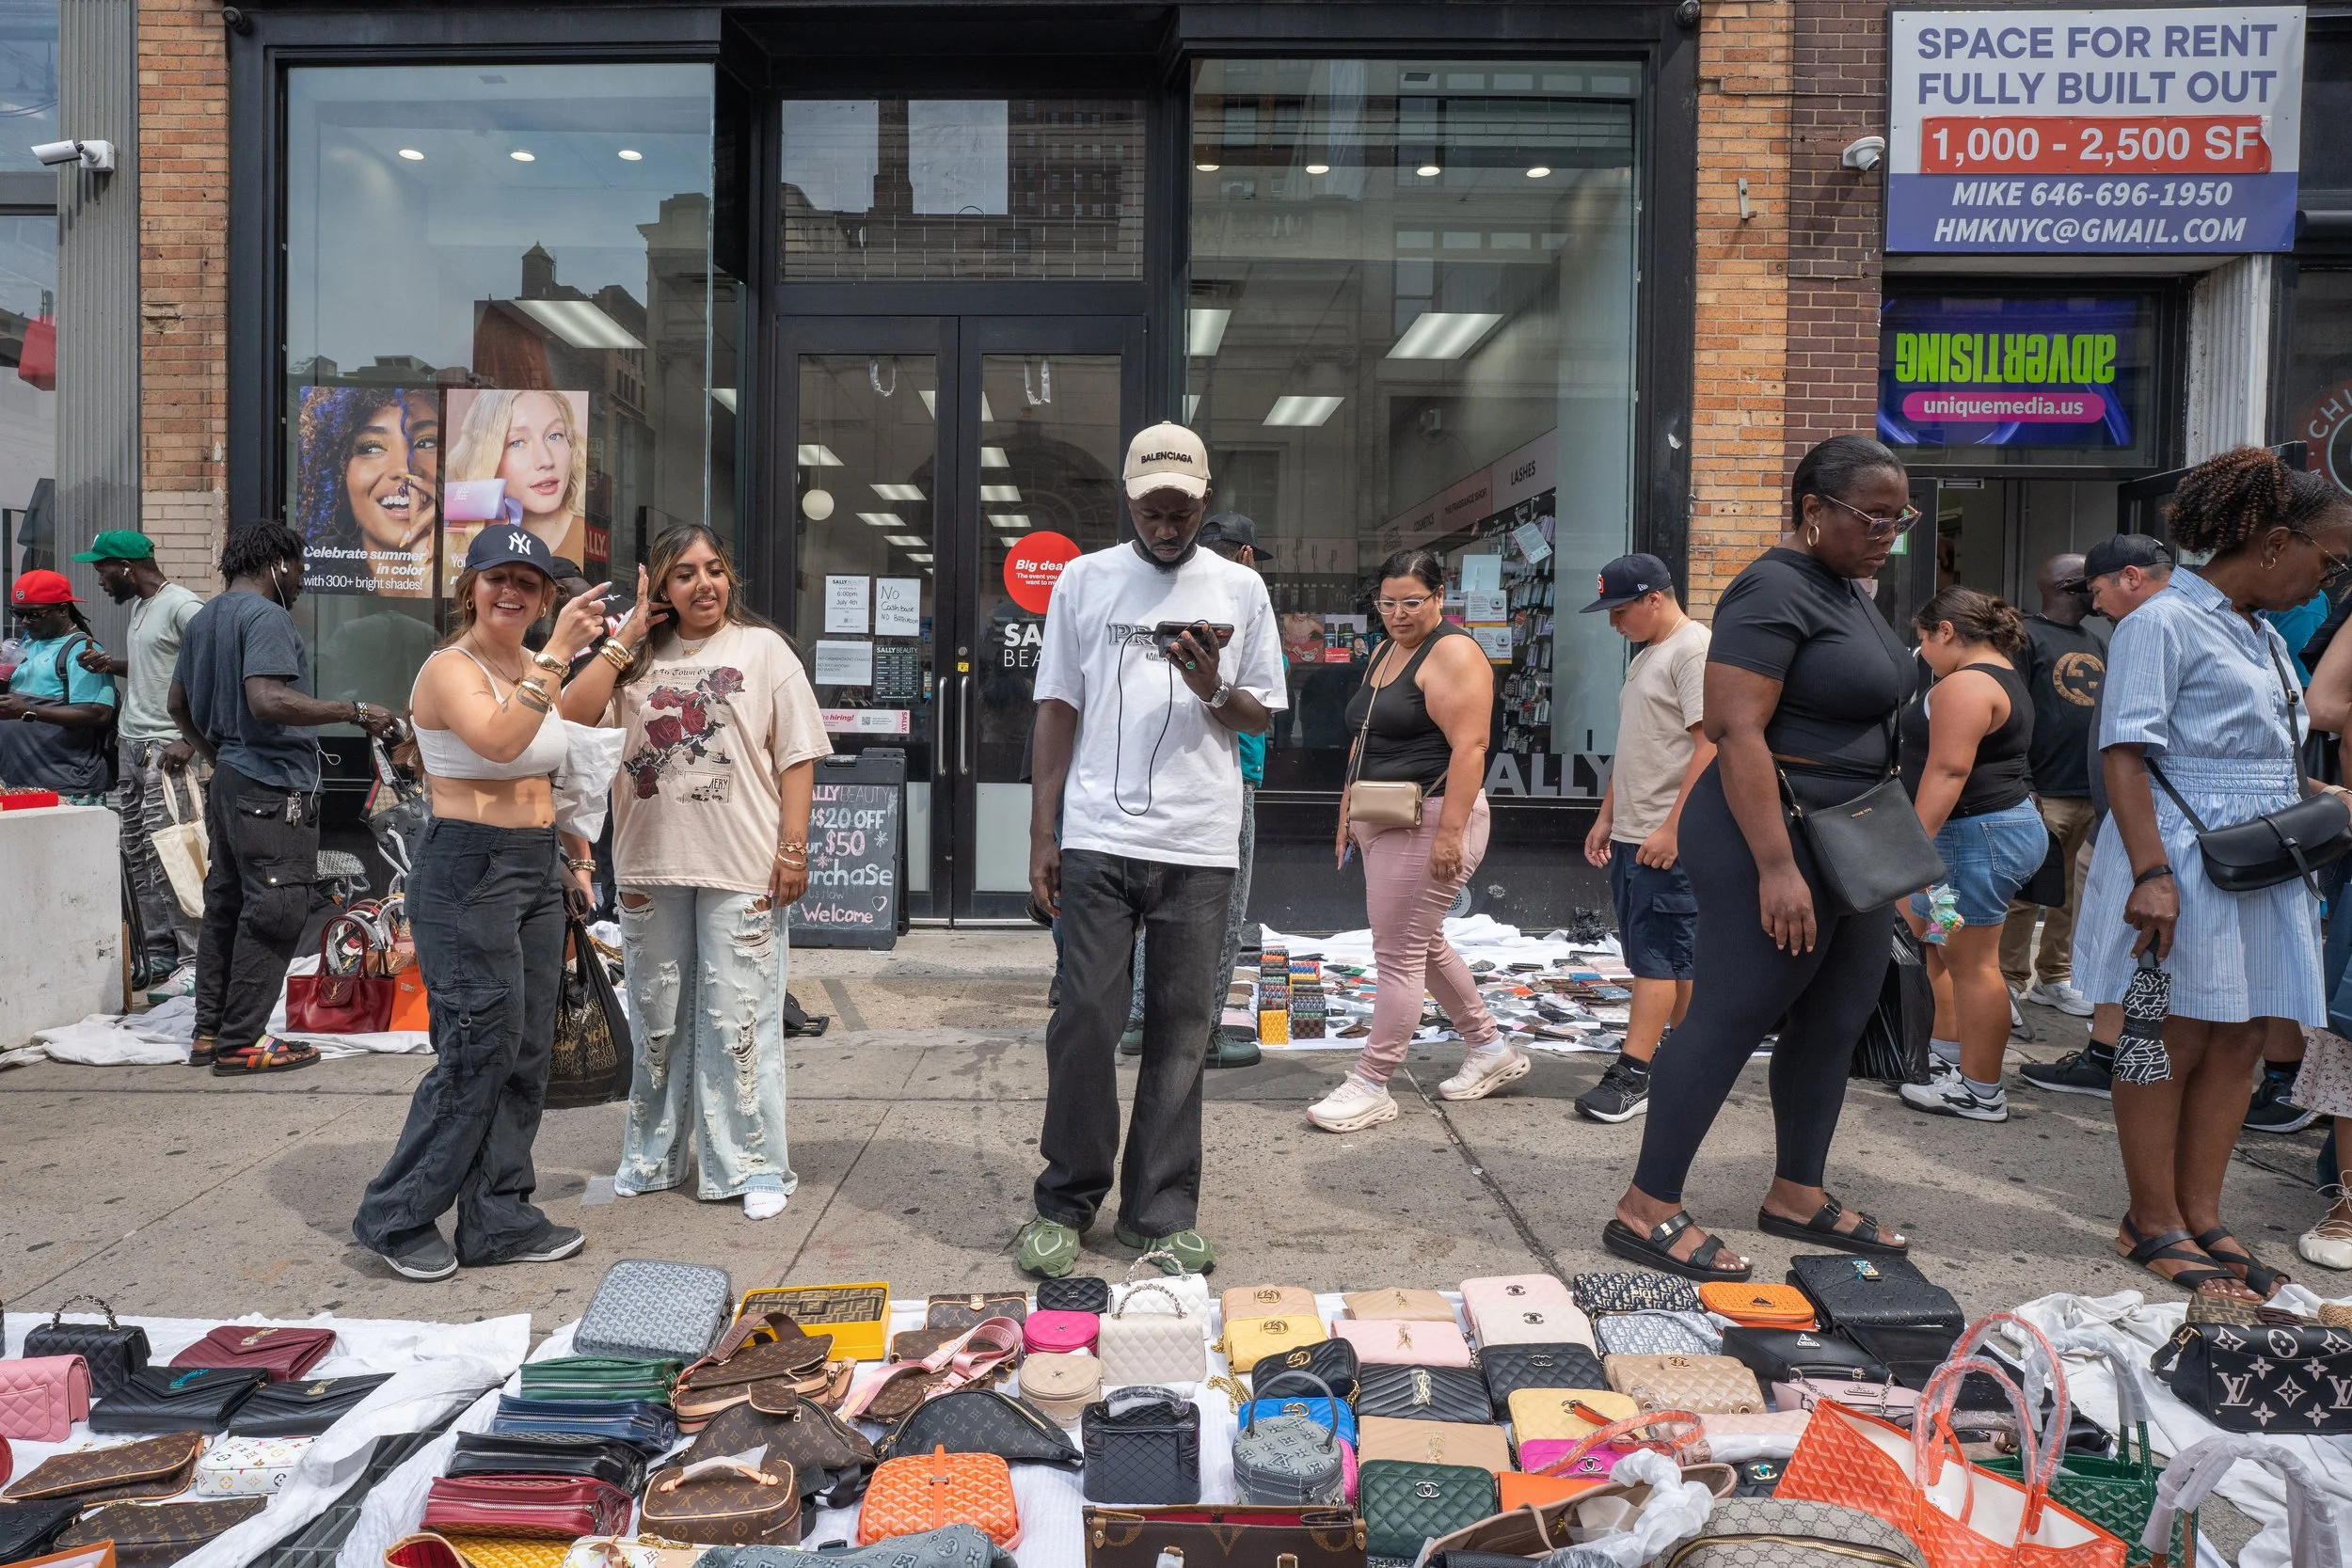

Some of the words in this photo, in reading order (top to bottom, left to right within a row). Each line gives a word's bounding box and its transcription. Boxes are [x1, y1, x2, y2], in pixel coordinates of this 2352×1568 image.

[1917, 25, 2055, 60] SPACE
[2068, 24, 2152, 59] FOR
[2165, 24, 2279, 57] RENT
[1918, 71, 2046, 105] FULLY
[2058, 71, 2176, 104] BUILT
[2186, 71, 2278, 104] OUT
[1931, 126, 2041, 166] 1,000
[2079, 126, 2190, 166] 2,500
[2203, 124, 2263, 160] SF
[1951, 182, 2023, 207] MIKE
[2030, 182, 2233, 207] 646-696-1950
[1933, 217, 2247, 245] HMKNYC@GMAIL.COM
[1923, 395, 2084, 420] uniquemedia.us
[1140, 451, 1193, 465] BALENCIAGA
[1510, 460, 1536, 486] LASHES
[1413, 512, 1435, 533] COSMETICS
[303, 545, 368, 560] Celebrate
[370, 548, 426, 562] summer
[1015, 559, 1038, 572] Big
[376, 563, 389, 575] in
[390, 563, 426, 576] color
[303, 575, 325, 587] with
[326, 575, 354, 588] 300+
[356, 576, 384, 592] bright
[385, 578, 422, 591] shades!
[830, 714, 855, 722] hiring!
[1484, 752, 1615, 799] ALLY
[816, 806, 851, 829] $20
[853, 809, 886, 830] OFF
[825, 829, 866, 857] $50
[800, 901, 874, 924] Welcome
